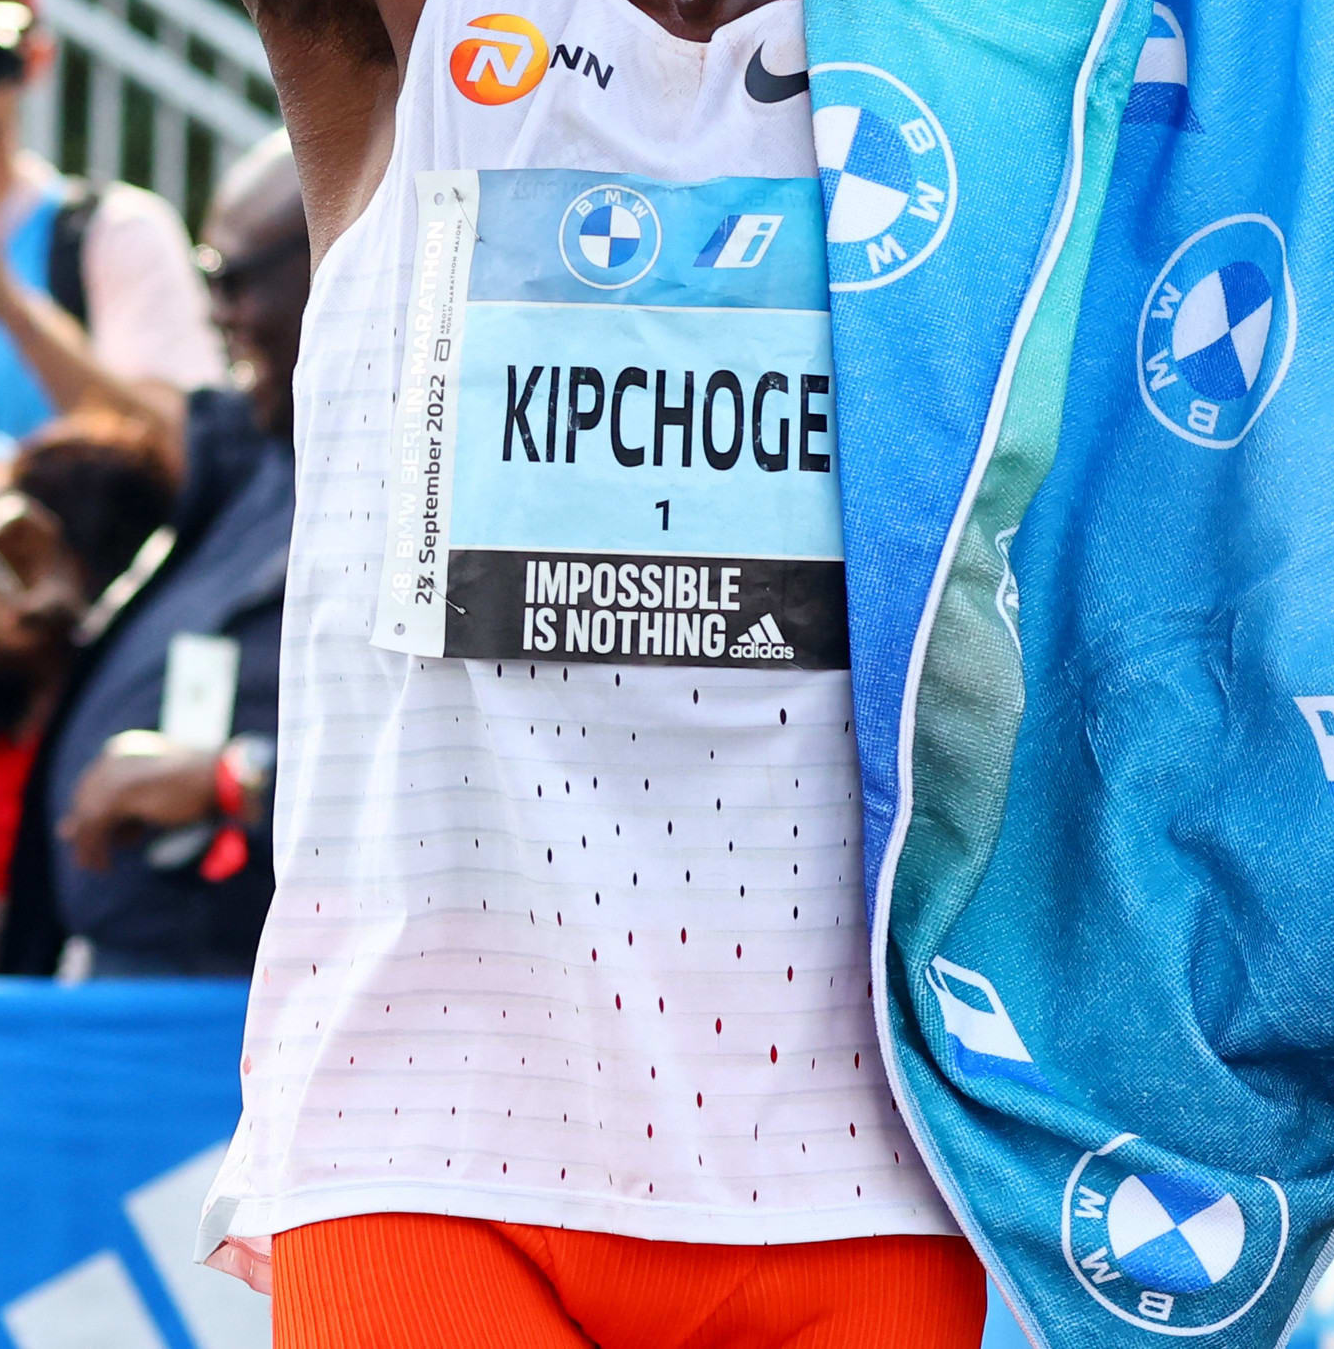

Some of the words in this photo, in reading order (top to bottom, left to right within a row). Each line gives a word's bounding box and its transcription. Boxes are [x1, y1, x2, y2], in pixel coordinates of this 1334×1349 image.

[549, 43, 615, 90] NN
[574, 189, 651, 219] BMW
[866, 117, 946, 275] BMW
[454, 219, 463, 253] MAJORS
[448, 256, 458, 304] MARATHON
[445, 306, 455, 335] WORLD
[400, 220, 445, 486] BERLIN-MARATHON
[1145, 281, 1220, 436] BMW
[425, 372, 446, 434] 2022
[502, 364, 832, 474] KIPCHOGE
[394, 490, 418, 559] BMW
[419, 437, 442, 565] September
[654, 499, 670, 531] 1
[525, 560, 742, 612] IMPOSSIBLE
[522, 605, 558, 653] IS
[564, 609, 727, 659] NOTHING
[728, 640, 795, 661] adidas
[1076, 1185, 1175, 1323] BMW
